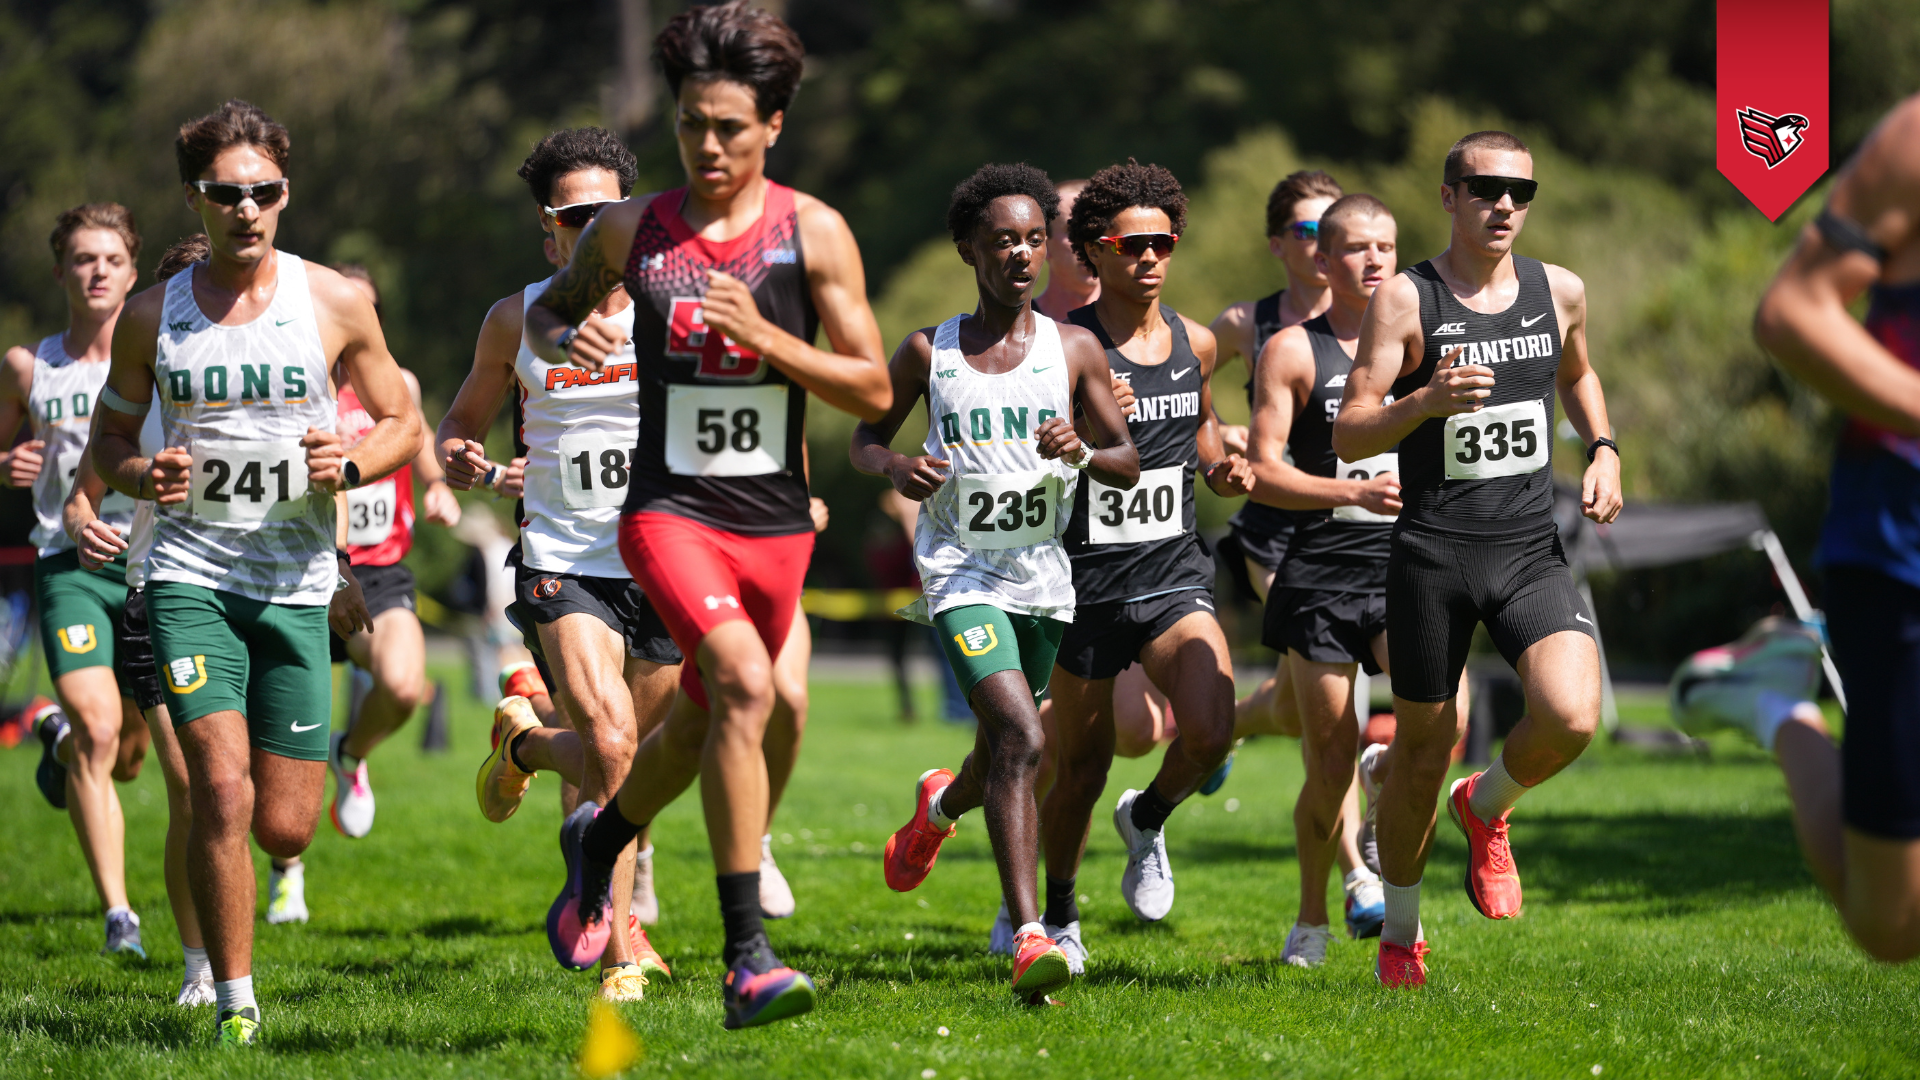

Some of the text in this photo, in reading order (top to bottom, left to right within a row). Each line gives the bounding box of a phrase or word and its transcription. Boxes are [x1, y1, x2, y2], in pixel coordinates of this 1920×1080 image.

[1432, 322, 1466, 336] ACC
[169, 364, 307, 402] DONS
[545, 362, 638, 391] PACIFI
[936, 369, 958, 379] WCC
[46, 393, 89, 421] DO
[1127, 391, 1199, 423] ANFORD
[697, 408, 760, 454] 58
[1455, 418, 1538, 464] 335
[202, 459, 290, 503] 241
[571, 448, 637, 491] 18
[968, 486, 1047, 532] 235
[1099, 484, 1175, 527] 340
